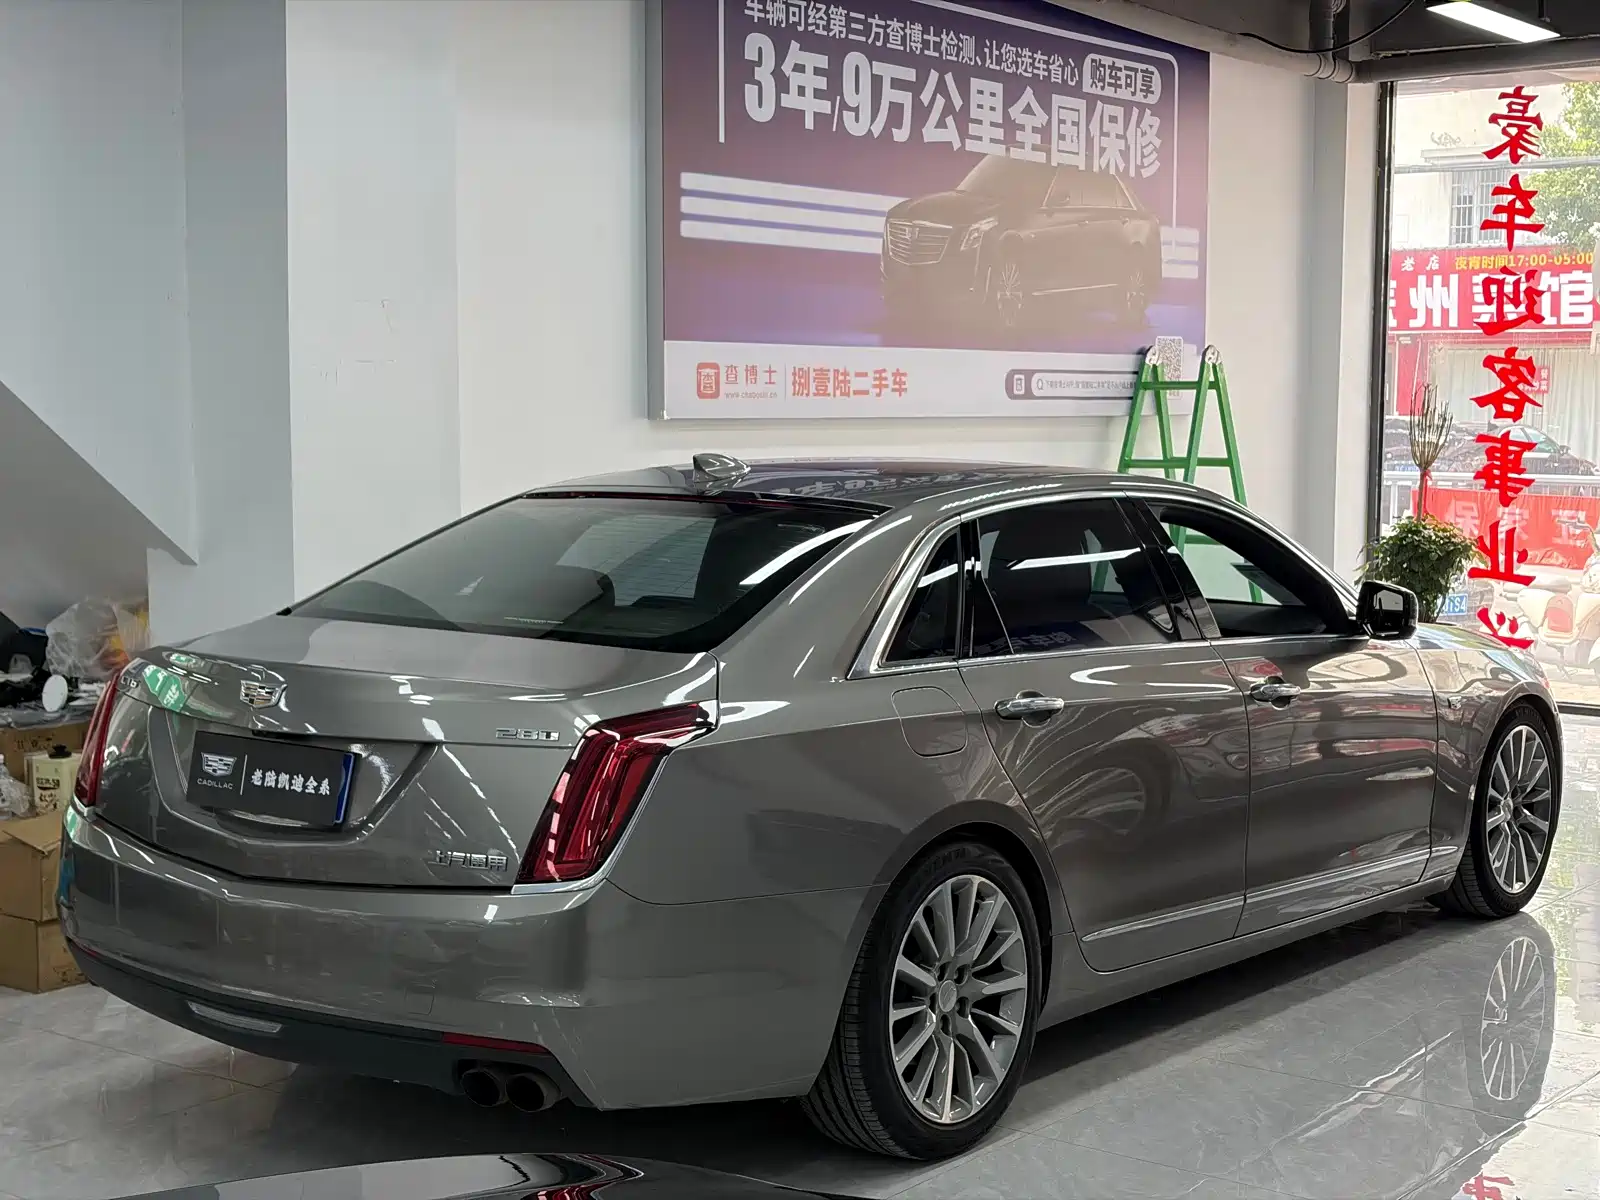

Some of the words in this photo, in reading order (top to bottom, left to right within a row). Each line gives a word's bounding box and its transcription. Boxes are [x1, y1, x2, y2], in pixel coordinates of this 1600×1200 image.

[744, 0, 1079, 86] 车辆可经第三方查博士检测、让您选车省心
[1089, 57, 1155, 99] 购车可享
[744, 32, 1163, 178] 3年/9万公里全国保修
[724, 363, 778, 387] 查博士
[791, 366, 908, 398] 捌壹陆二手车
[196, 777, 234, 790] CADILLAC
